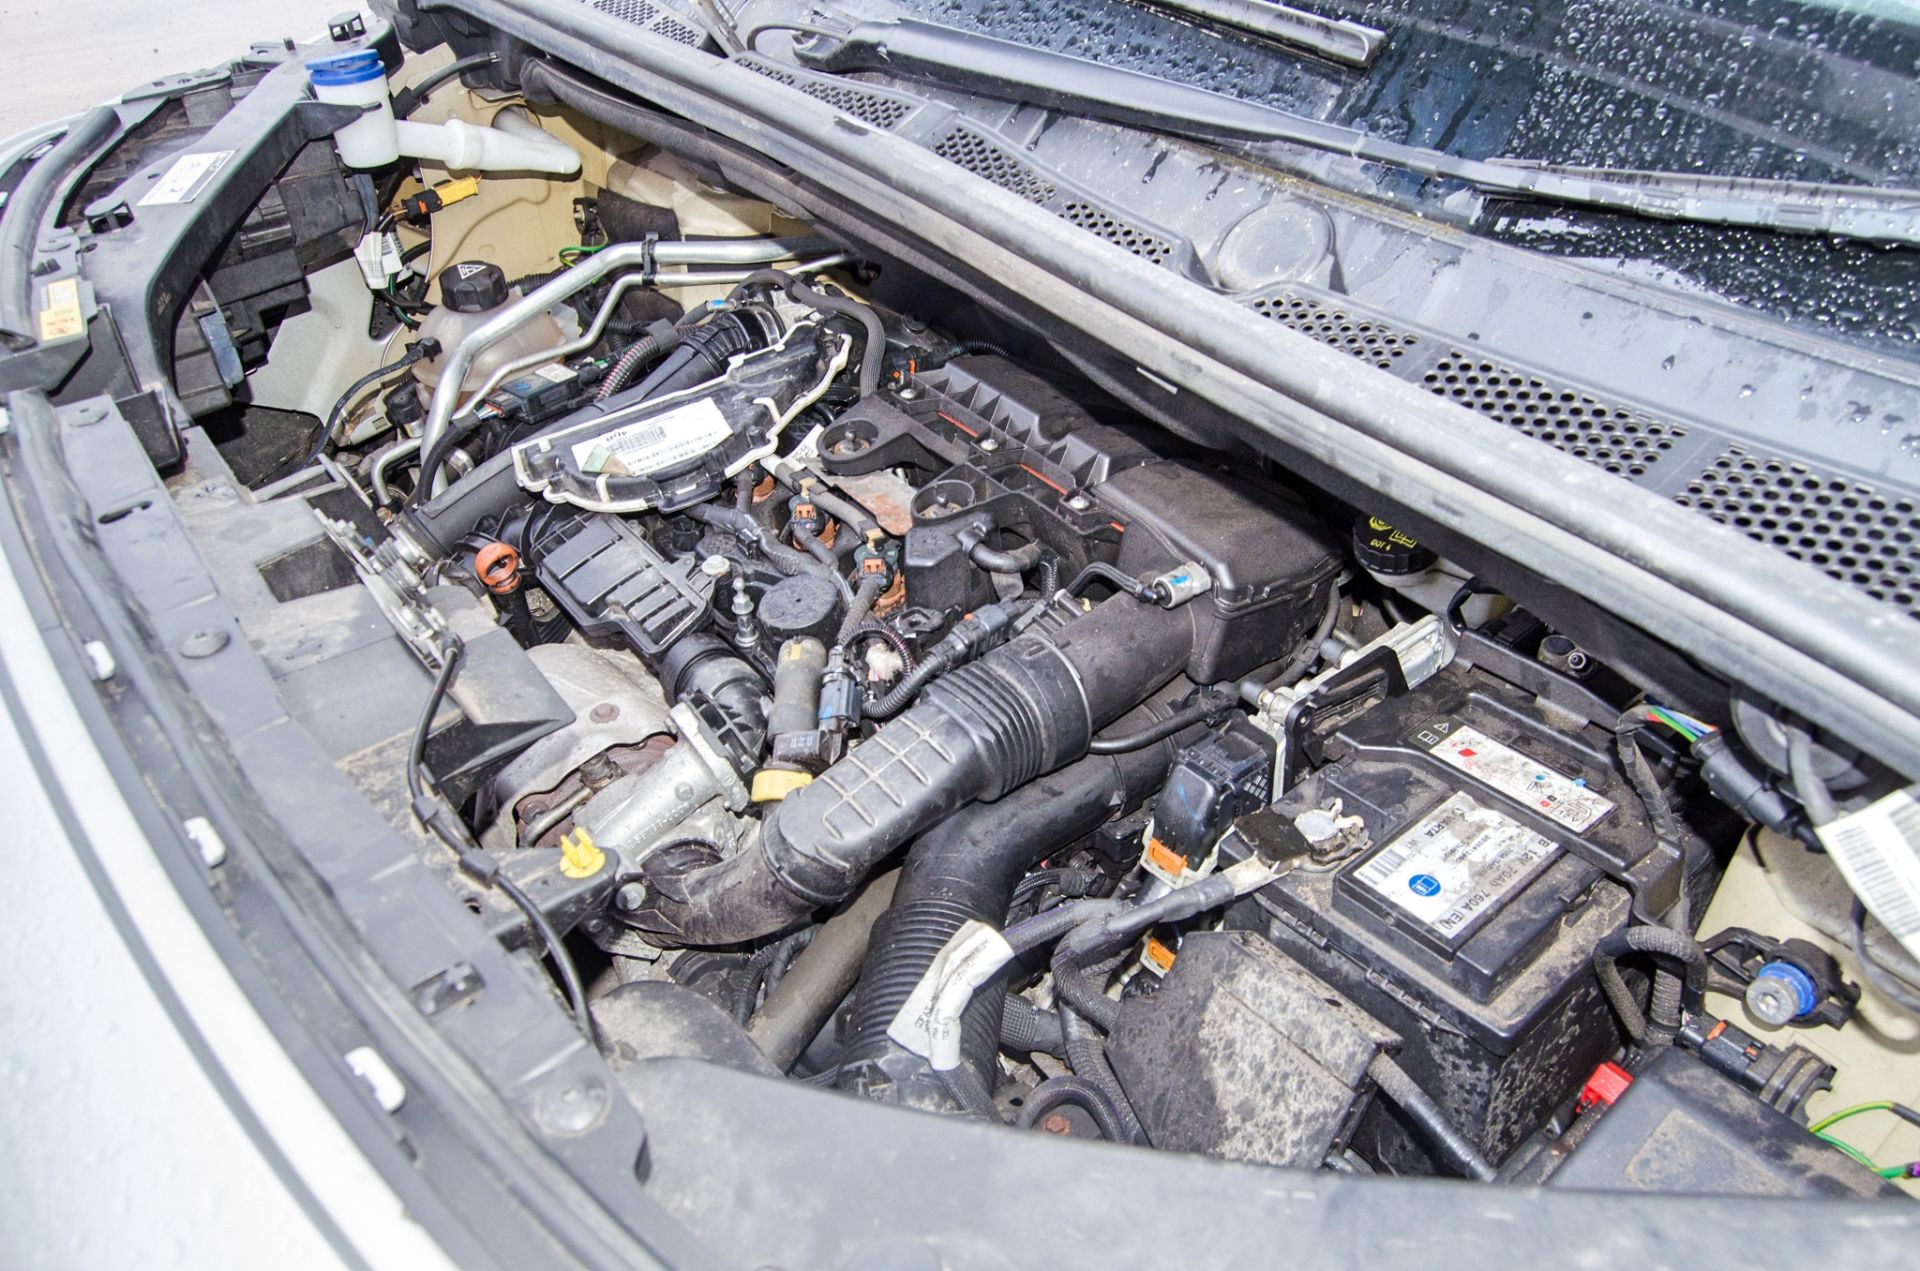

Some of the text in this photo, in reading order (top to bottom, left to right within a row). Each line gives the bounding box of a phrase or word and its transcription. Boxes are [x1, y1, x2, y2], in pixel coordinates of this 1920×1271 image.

[1370, 538, 1387, 549] DOT
[1423, 814, 1456, 838] VARTA
[1517, 849, 1538, 866] 12V
[1488, 866, 1518, 888] 70Ah
